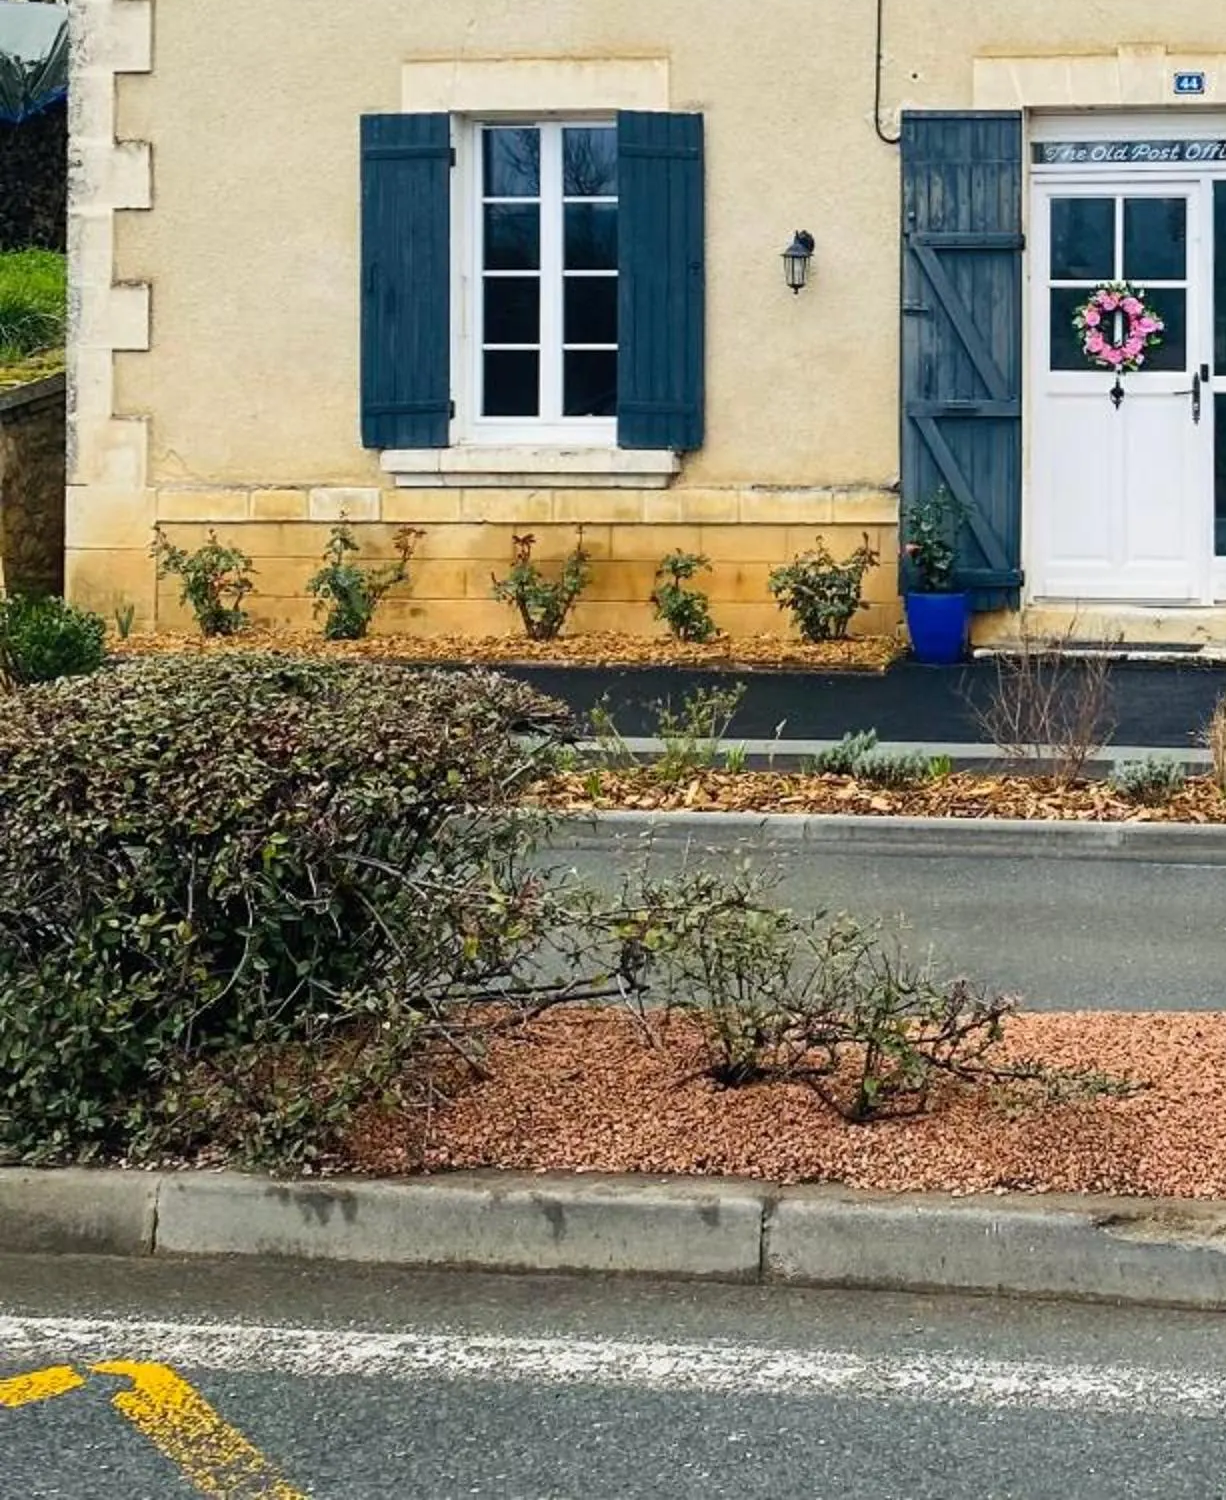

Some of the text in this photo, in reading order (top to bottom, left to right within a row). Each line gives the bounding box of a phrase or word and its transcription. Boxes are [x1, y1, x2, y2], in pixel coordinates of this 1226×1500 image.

[1180, 77, 1199, 89] 44
[1045, 143, 1087, 161] The
[1091, 144, 1128, 161] Old
[1130, 143, 1179, 161] Post
